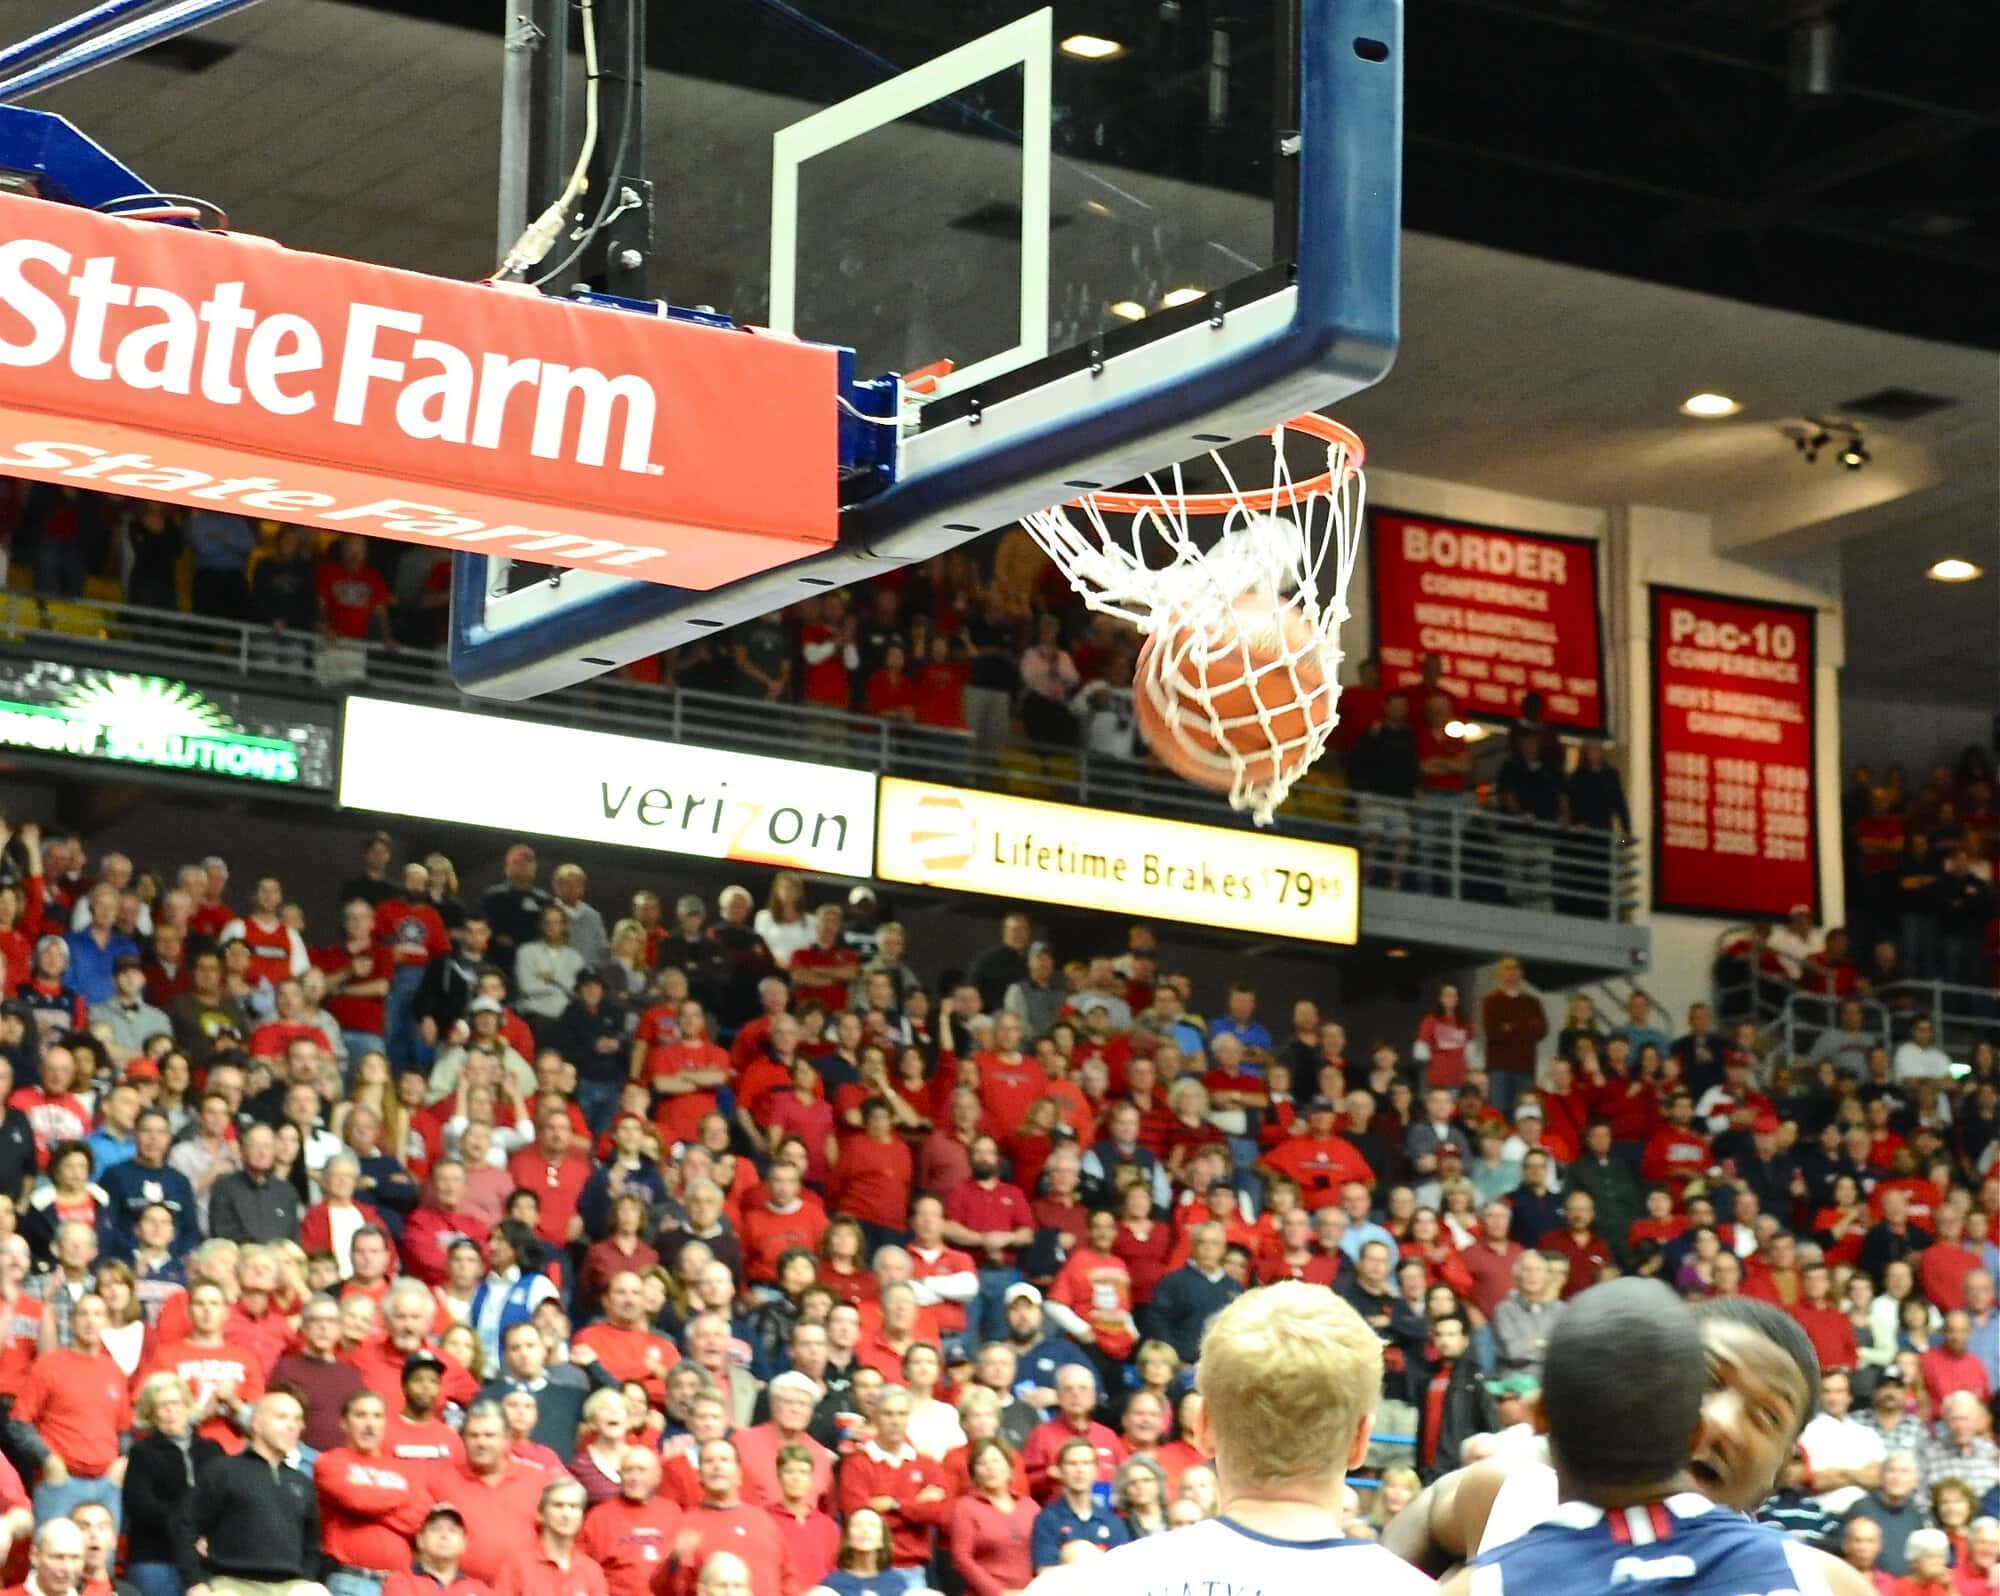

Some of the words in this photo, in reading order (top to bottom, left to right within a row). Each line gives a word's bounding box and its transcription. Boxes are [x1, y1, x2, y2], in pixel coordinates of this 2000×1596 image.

[0, 239, 324, 416] State
[333, 302, 657, 475] Farm
[0, 440, 336, 512] State
[317, 499, 668, 567] Farm
[1402, 525, 1567, 586] BORDER
[1670, 608, 1797, 661] Pac-10
[107, 722, 299, 784] SOLUTIONS
[601, 780, 848, 856] verizon
[994, 831, 1128, 882] Lifetime
[1143, 853, 1252, 900] Brakes
